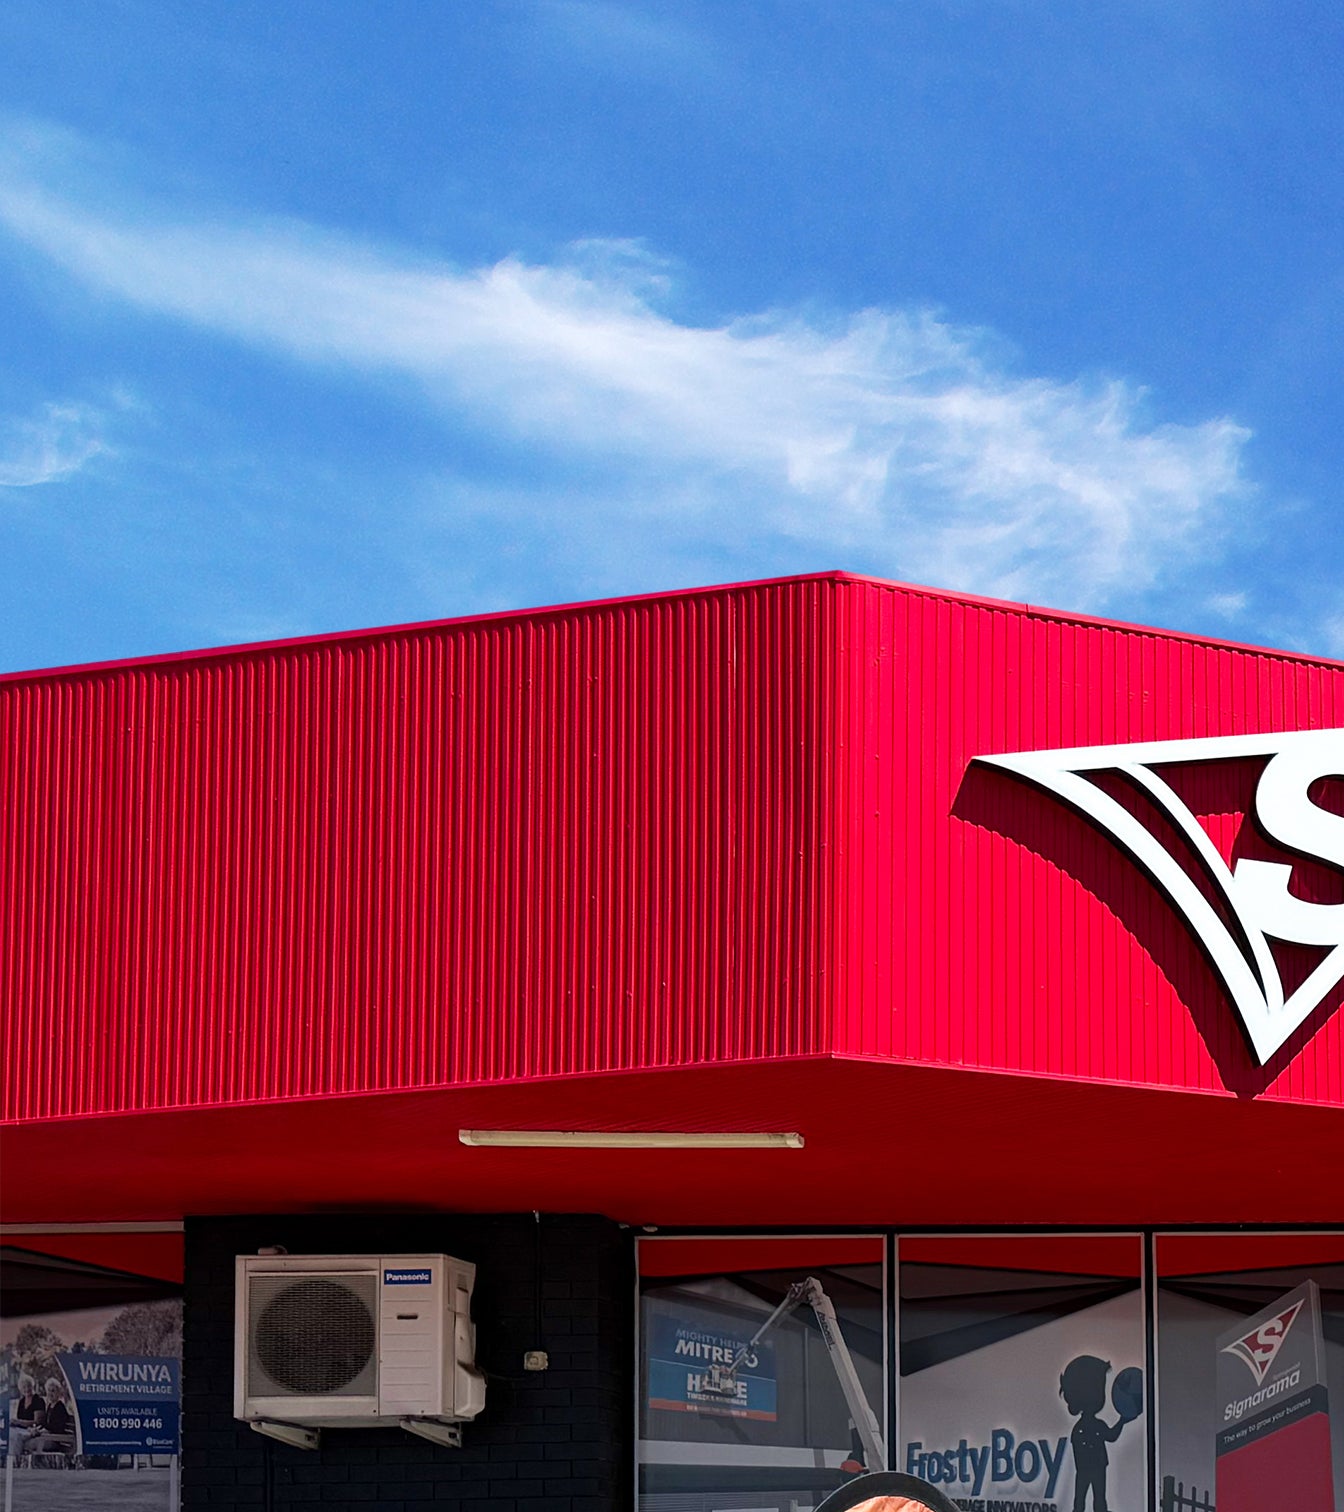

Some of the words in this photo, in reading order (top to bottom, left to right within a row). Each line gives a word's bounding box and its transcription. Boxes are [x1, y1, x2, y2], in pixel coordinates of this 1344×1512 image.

[386, 1273, 429, 1281] Panasonic
[674, 1339, 733, 1364] MITRE
[79, 1361, 172, 1383] WIRUNYA
[80, 1384, 135, 1394] RETIREMENT
[136, 1385, 173, 1395] VILLAGE
[1223, 1369, 1300, 1421] Signarama
[93, 1417, 119, 1429] 1800
[121, 1418, 141, 1429] 990
[142, 1418, 162, 1430] 446
